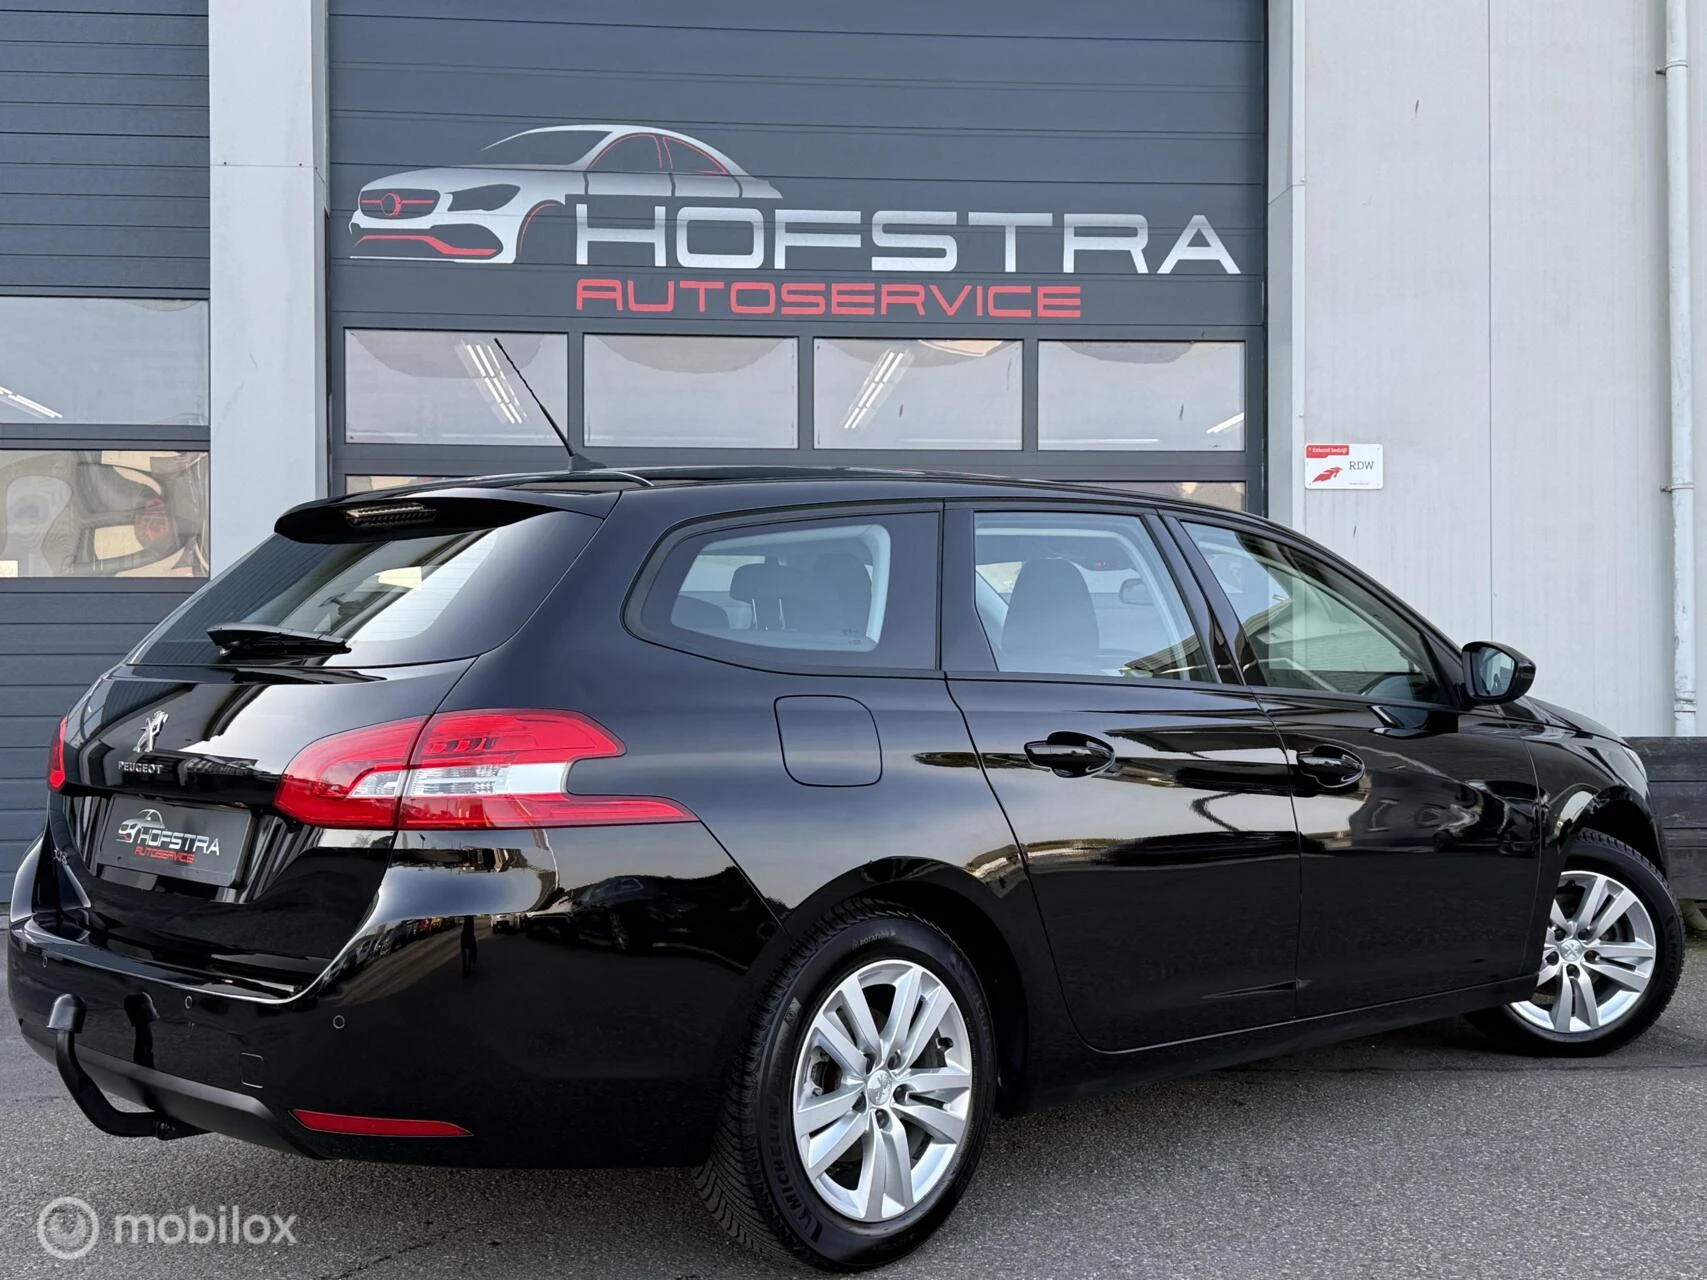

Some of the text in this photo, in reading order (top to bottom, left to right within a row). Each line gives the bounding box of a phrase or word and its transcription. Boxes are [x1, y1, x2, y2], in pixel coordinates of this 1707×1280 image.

[576, 203, 1241, 275] HOFSTRA
[575, 279, 1082, 319] AUTOSERVICE
[1349, 461, 1374, 470] RDW
[118, 760, 164, 775] PEUGEOT
[138, 829, 220, 857] HOFSTRA
